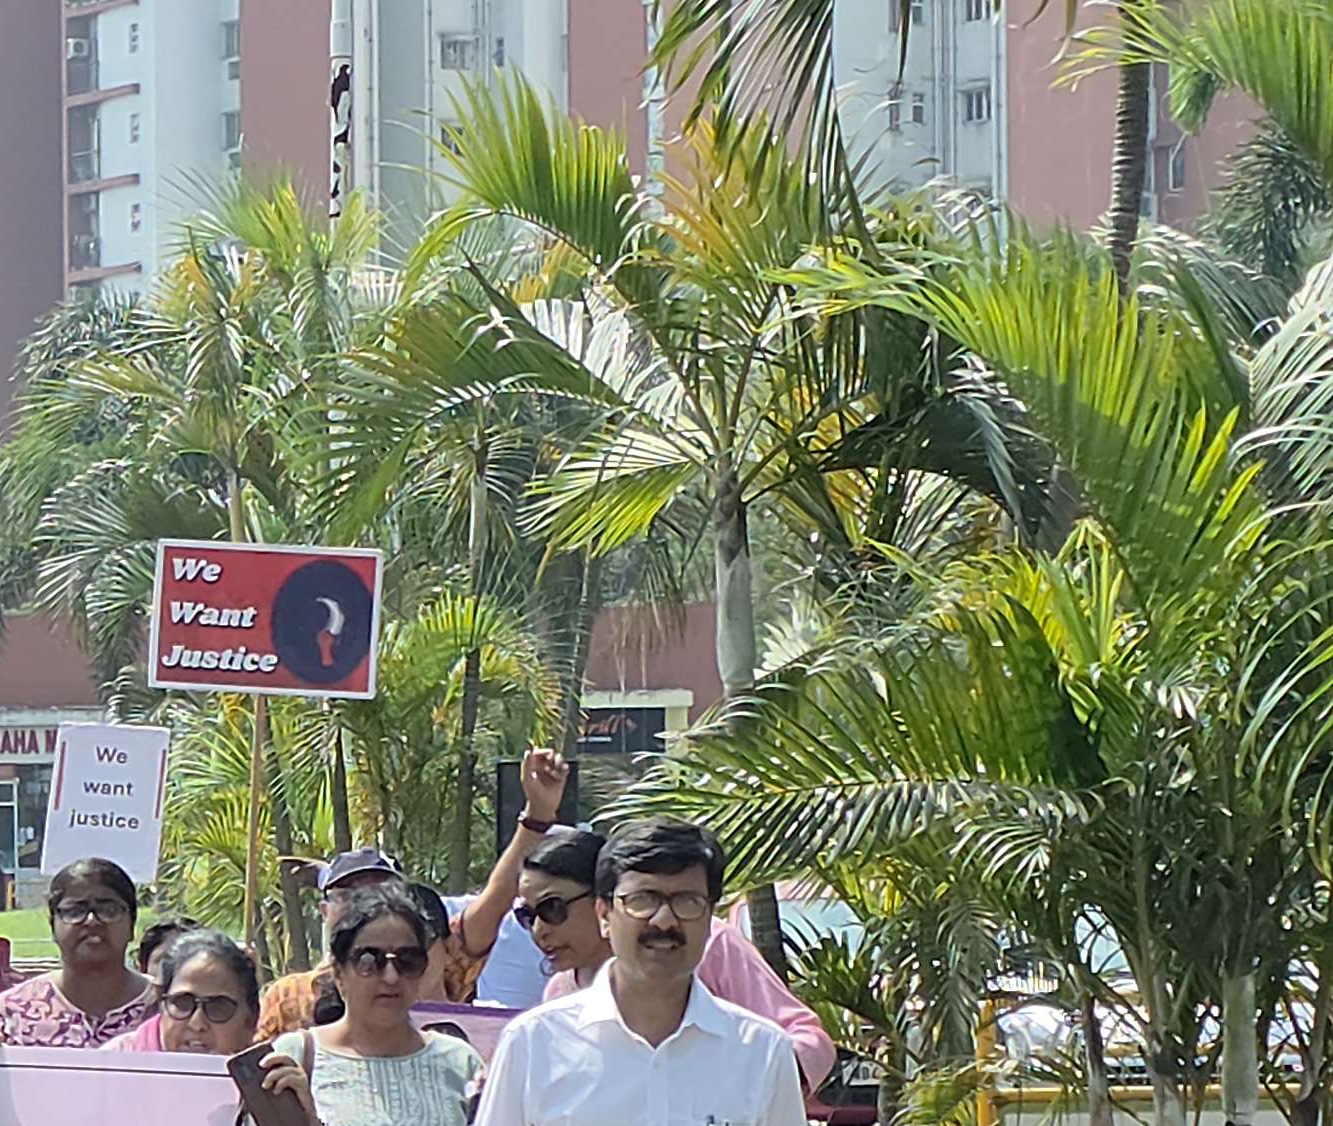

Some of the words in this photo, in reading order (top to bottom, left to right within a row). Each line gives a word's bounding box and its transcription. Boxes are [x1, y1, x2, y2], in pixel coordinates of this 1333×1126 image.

[172, 557, 222, 582] We
[169, 600, 258, 628] Want
[161, 644, 279, 673] Justice
[96, 745, 128, 765] We
[83, 780, 134, 797] want
[69, 808, 140, 830] justice
